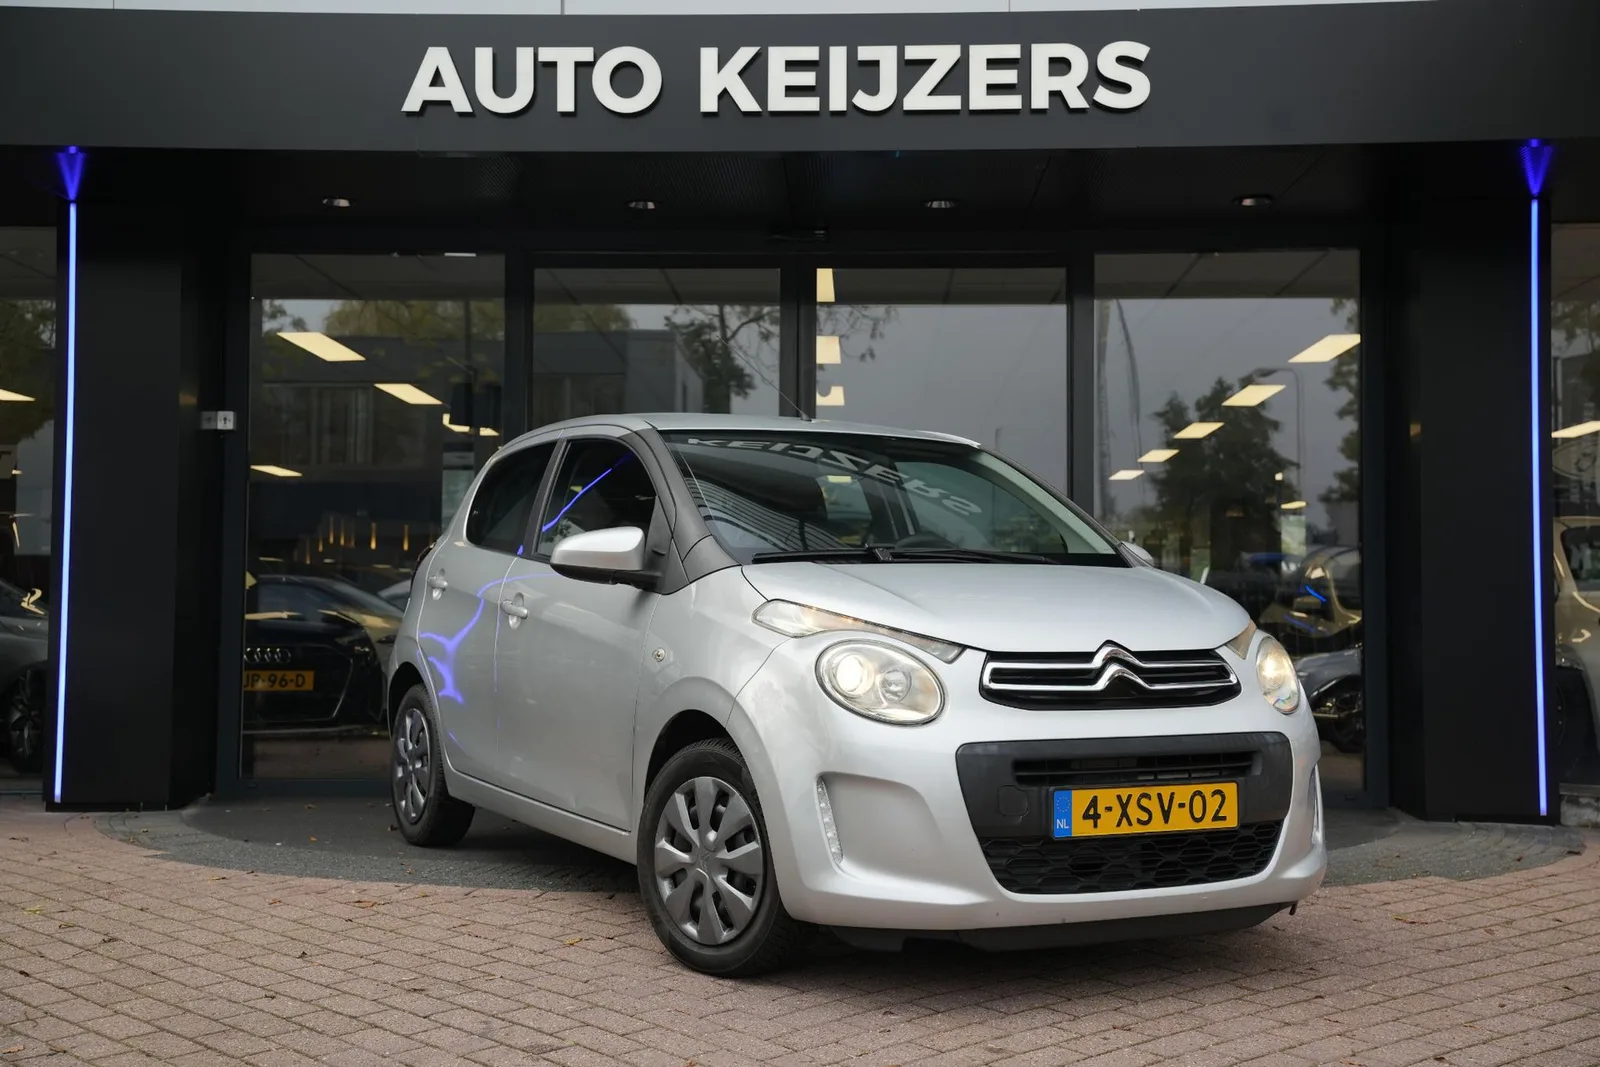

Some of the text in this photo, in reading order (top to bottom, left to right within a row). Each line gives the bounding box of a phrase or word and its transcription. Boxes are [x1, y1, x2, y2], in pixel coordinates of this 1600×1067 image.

[401, 41, 1151, 114] AUTO KEIJZERS
[1056, 819, 1069, 829] NL
[1082, 789, 1228, 829] 4-XSV-02
